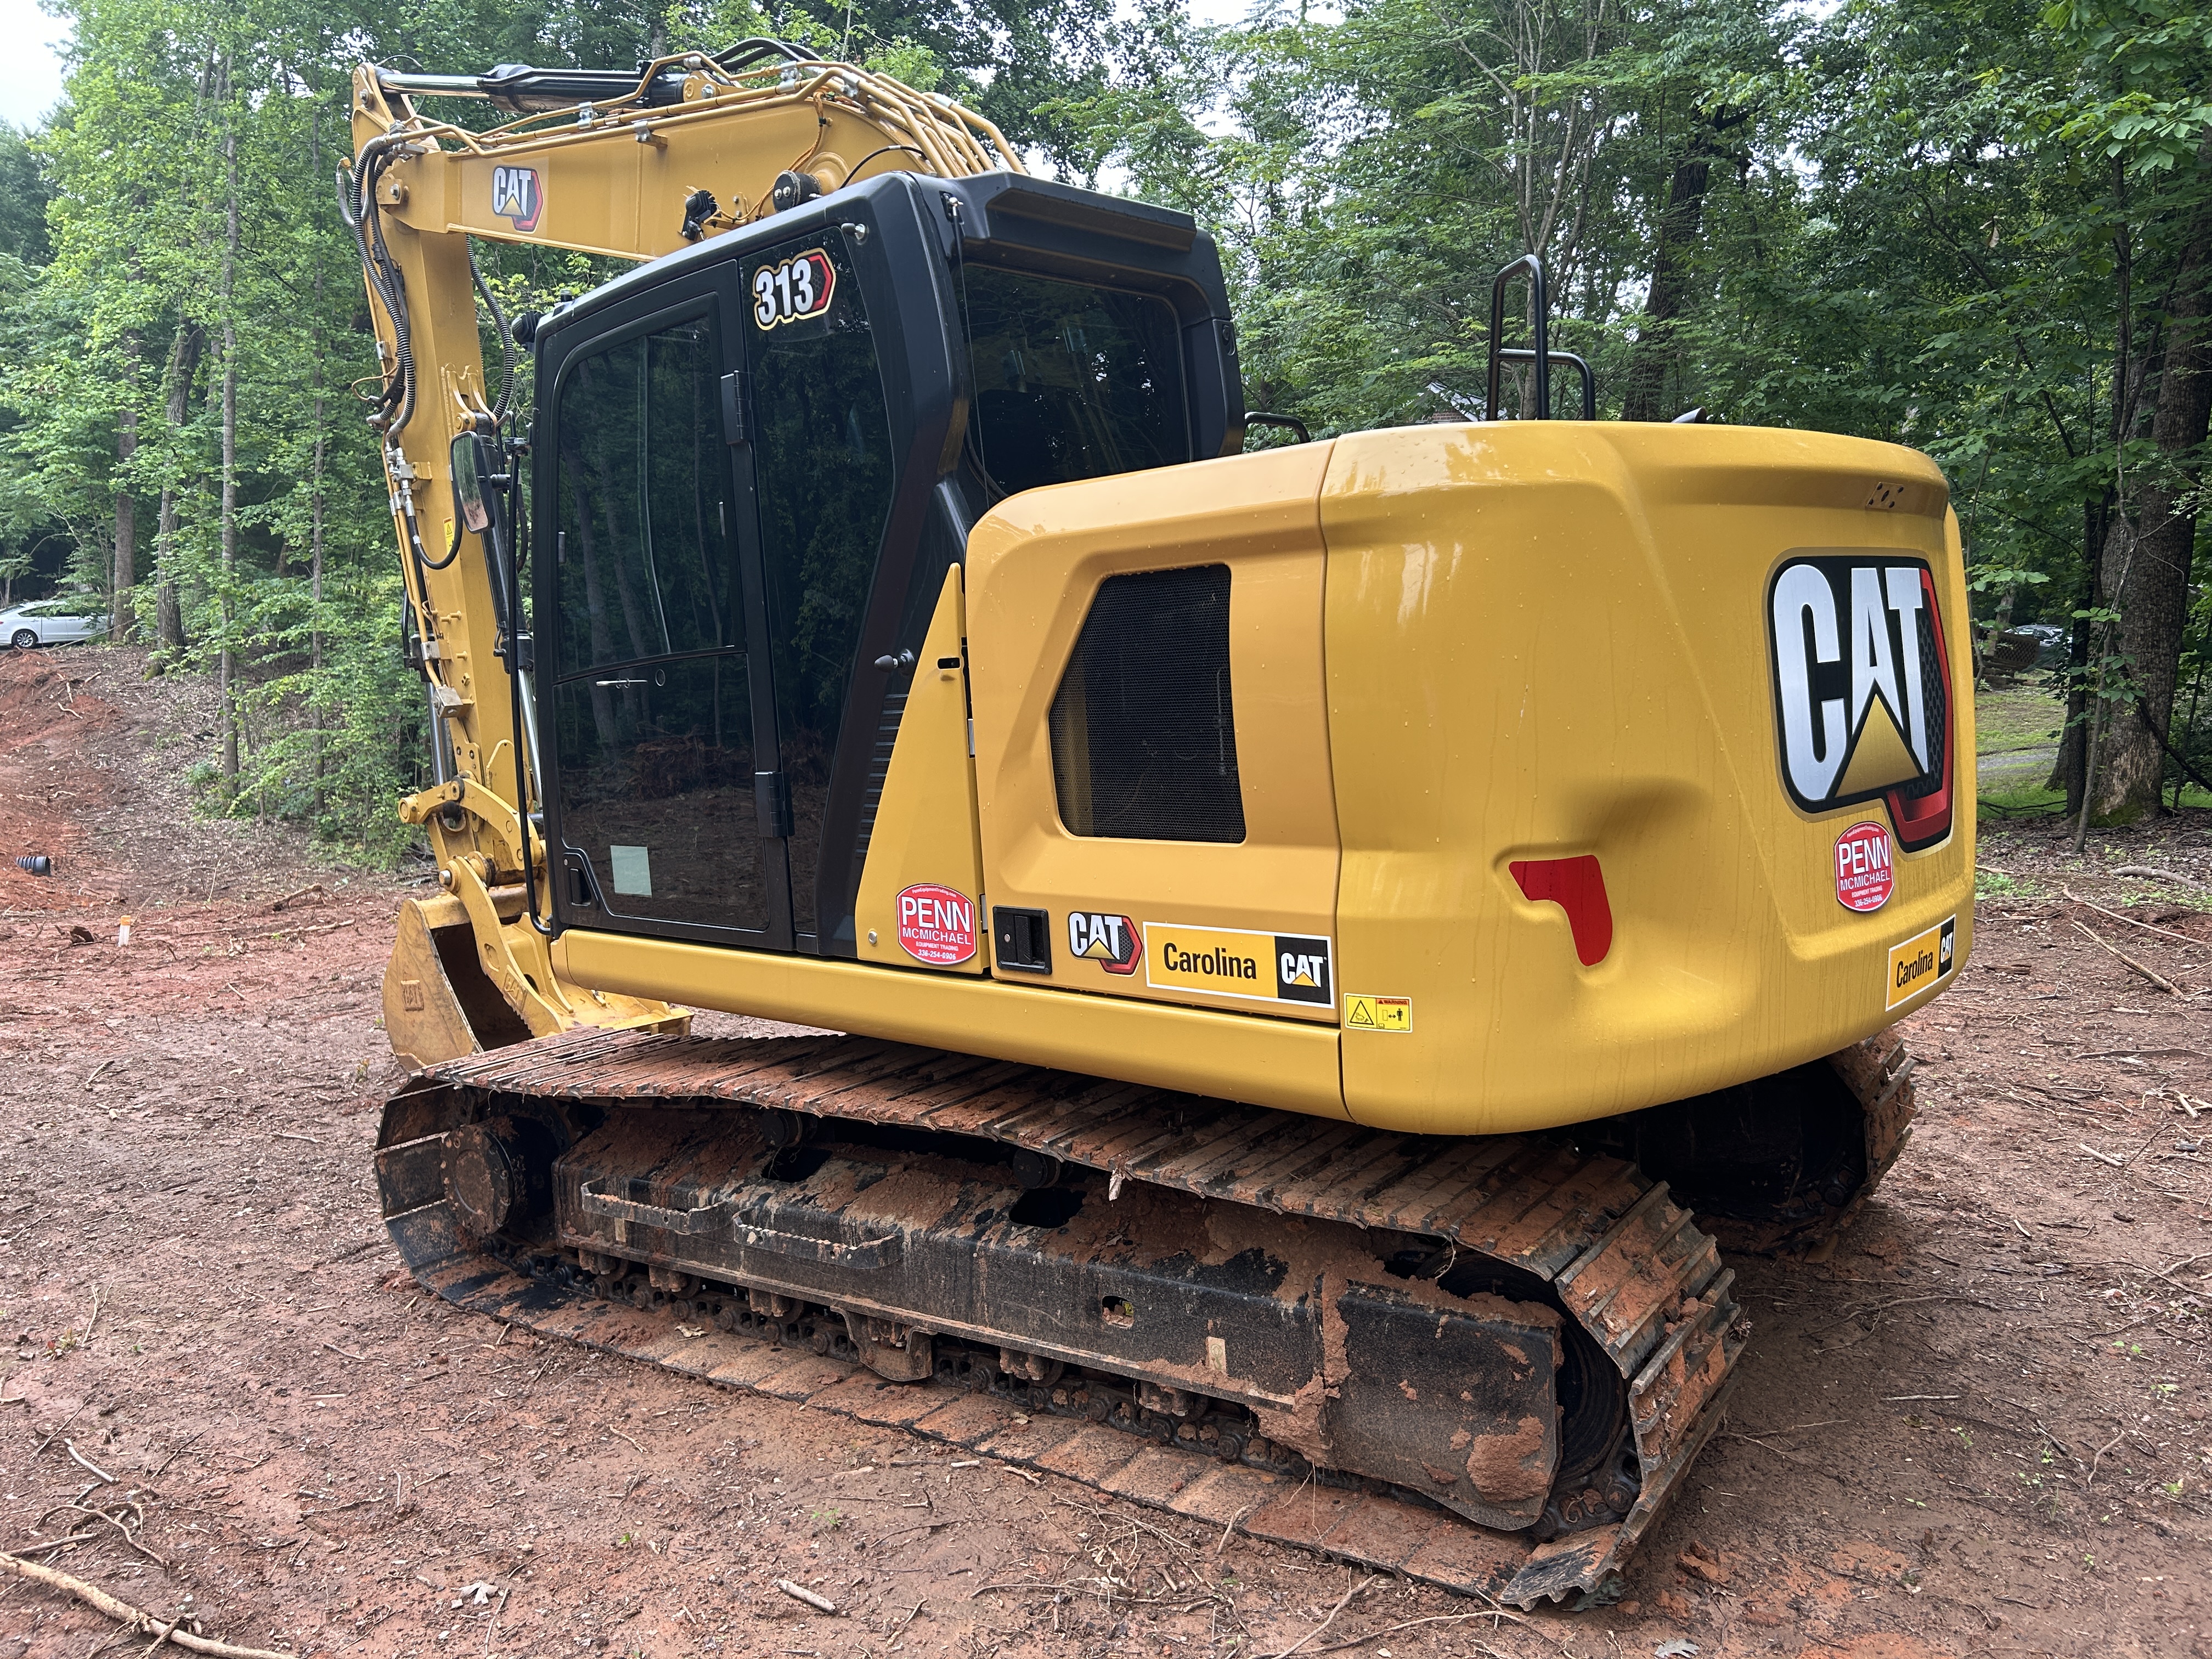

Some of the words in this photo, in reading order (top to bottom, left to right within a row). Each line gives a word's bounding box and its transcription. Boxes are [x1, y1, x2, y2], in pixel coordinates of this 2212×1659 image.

[494, 167, 531, 216] CAT
[756, 258, 814, 324] 313
[1774, 565, 1929, 800] CAT
[1838, 835, 1889, 877] PENN
[1840, 870, 1891, 891] MCMICHAEL
[901, 896, 970, 933] PENN
[902, 927, 972, 945] MCMICHAEL
[1069, 912, 1122, 960] CAT
[1164, 942, 1257, 979] Carolina
[1280, 952, 1324, 988] CAT
[1896, 950, 1933, 988] Carolina
[1940, 932, 1953, 963] CAT
